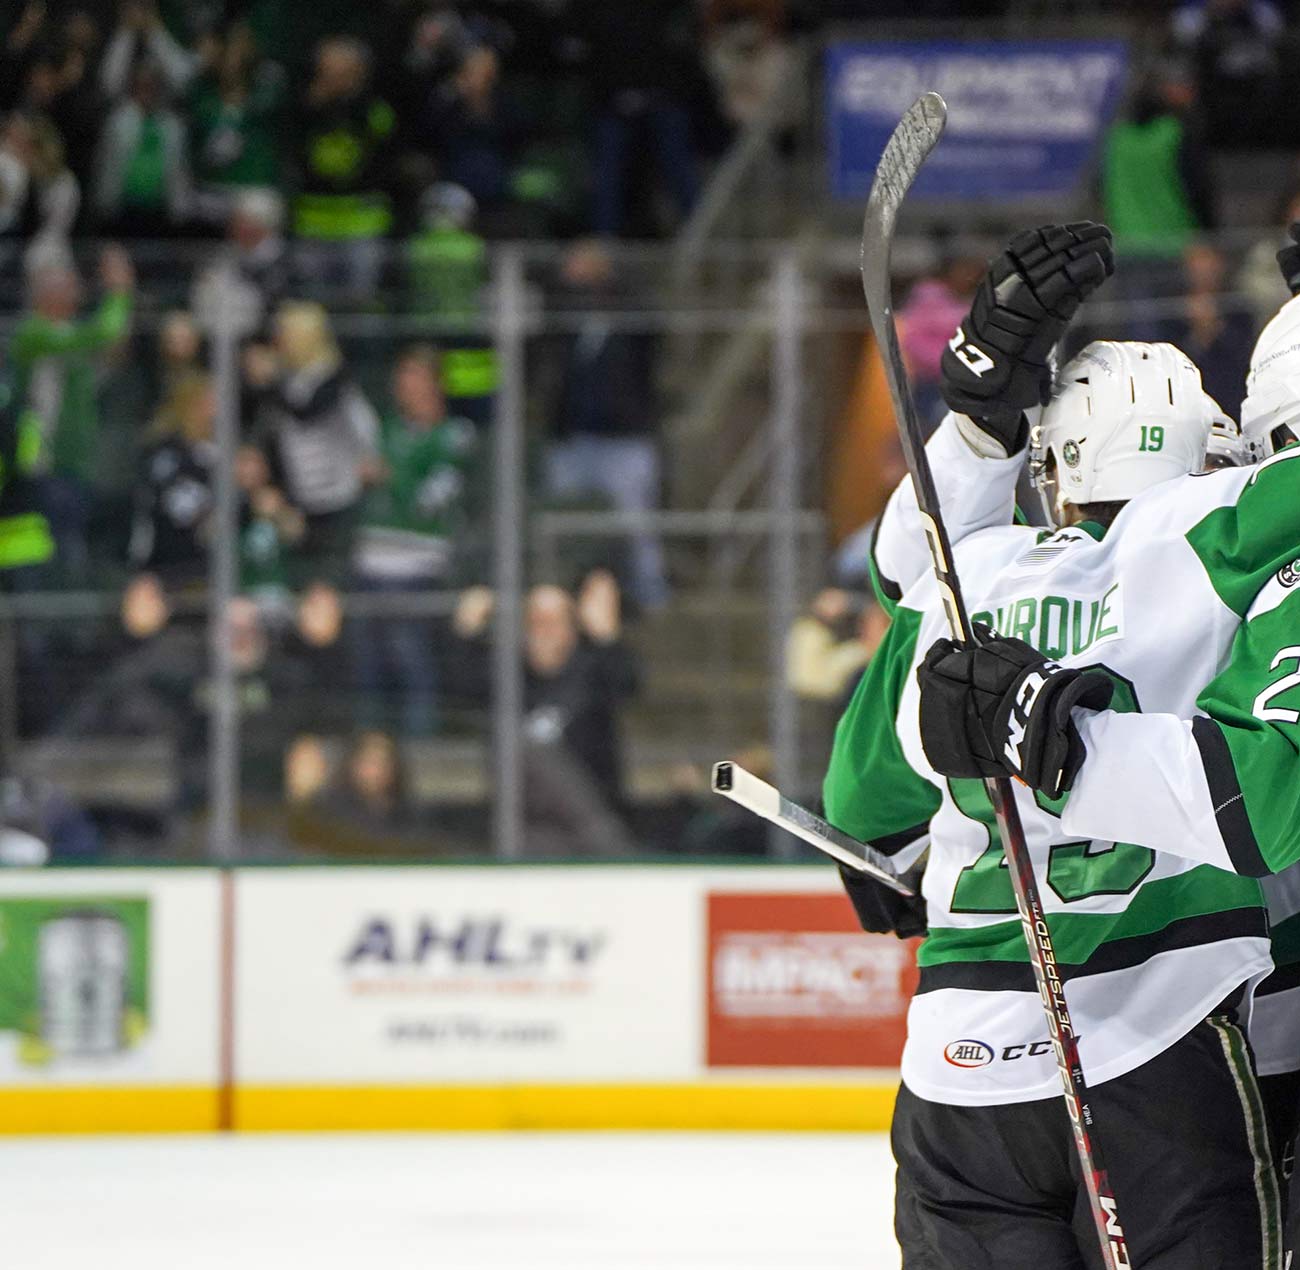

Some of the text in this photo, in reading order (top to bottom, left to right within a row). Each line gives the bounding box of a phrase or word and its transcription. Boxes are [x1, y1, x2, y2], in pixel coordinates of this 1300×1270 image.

[1138, 425, 1165, 452] 19
[1035, 920, 1075, 1039] JETSPEED
[952, 1045, 985, 1061] AHL
